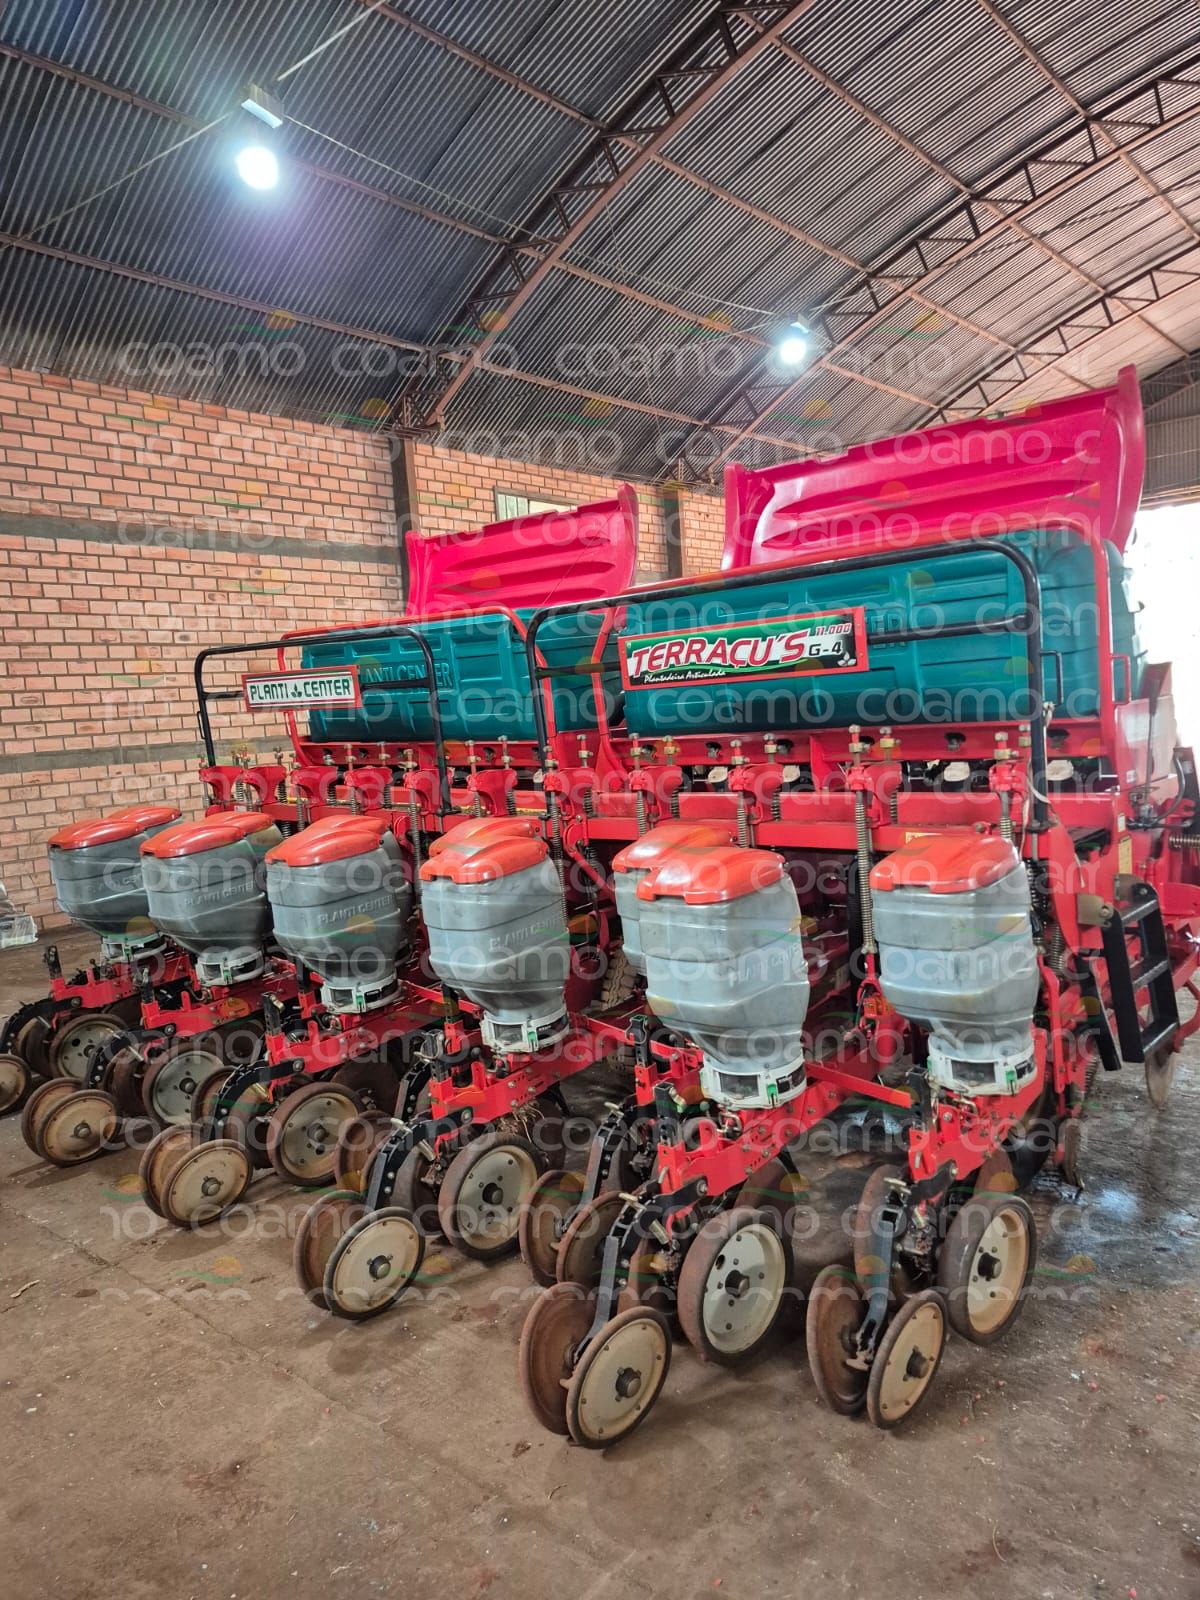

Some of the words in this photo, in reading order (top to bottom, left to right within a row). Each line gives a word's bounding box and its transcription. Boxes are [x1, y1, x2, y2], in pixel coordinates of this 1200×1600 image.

[815, 623, 851, 636] 11.000
[809, 641, 842, 656] G-4
[364, 666, 394, 683] ANTI
[396, 662, 453, 688] CENER
[250, 684, 288, 700] PLANTI
[304, 678, 351, 697] CENTER
